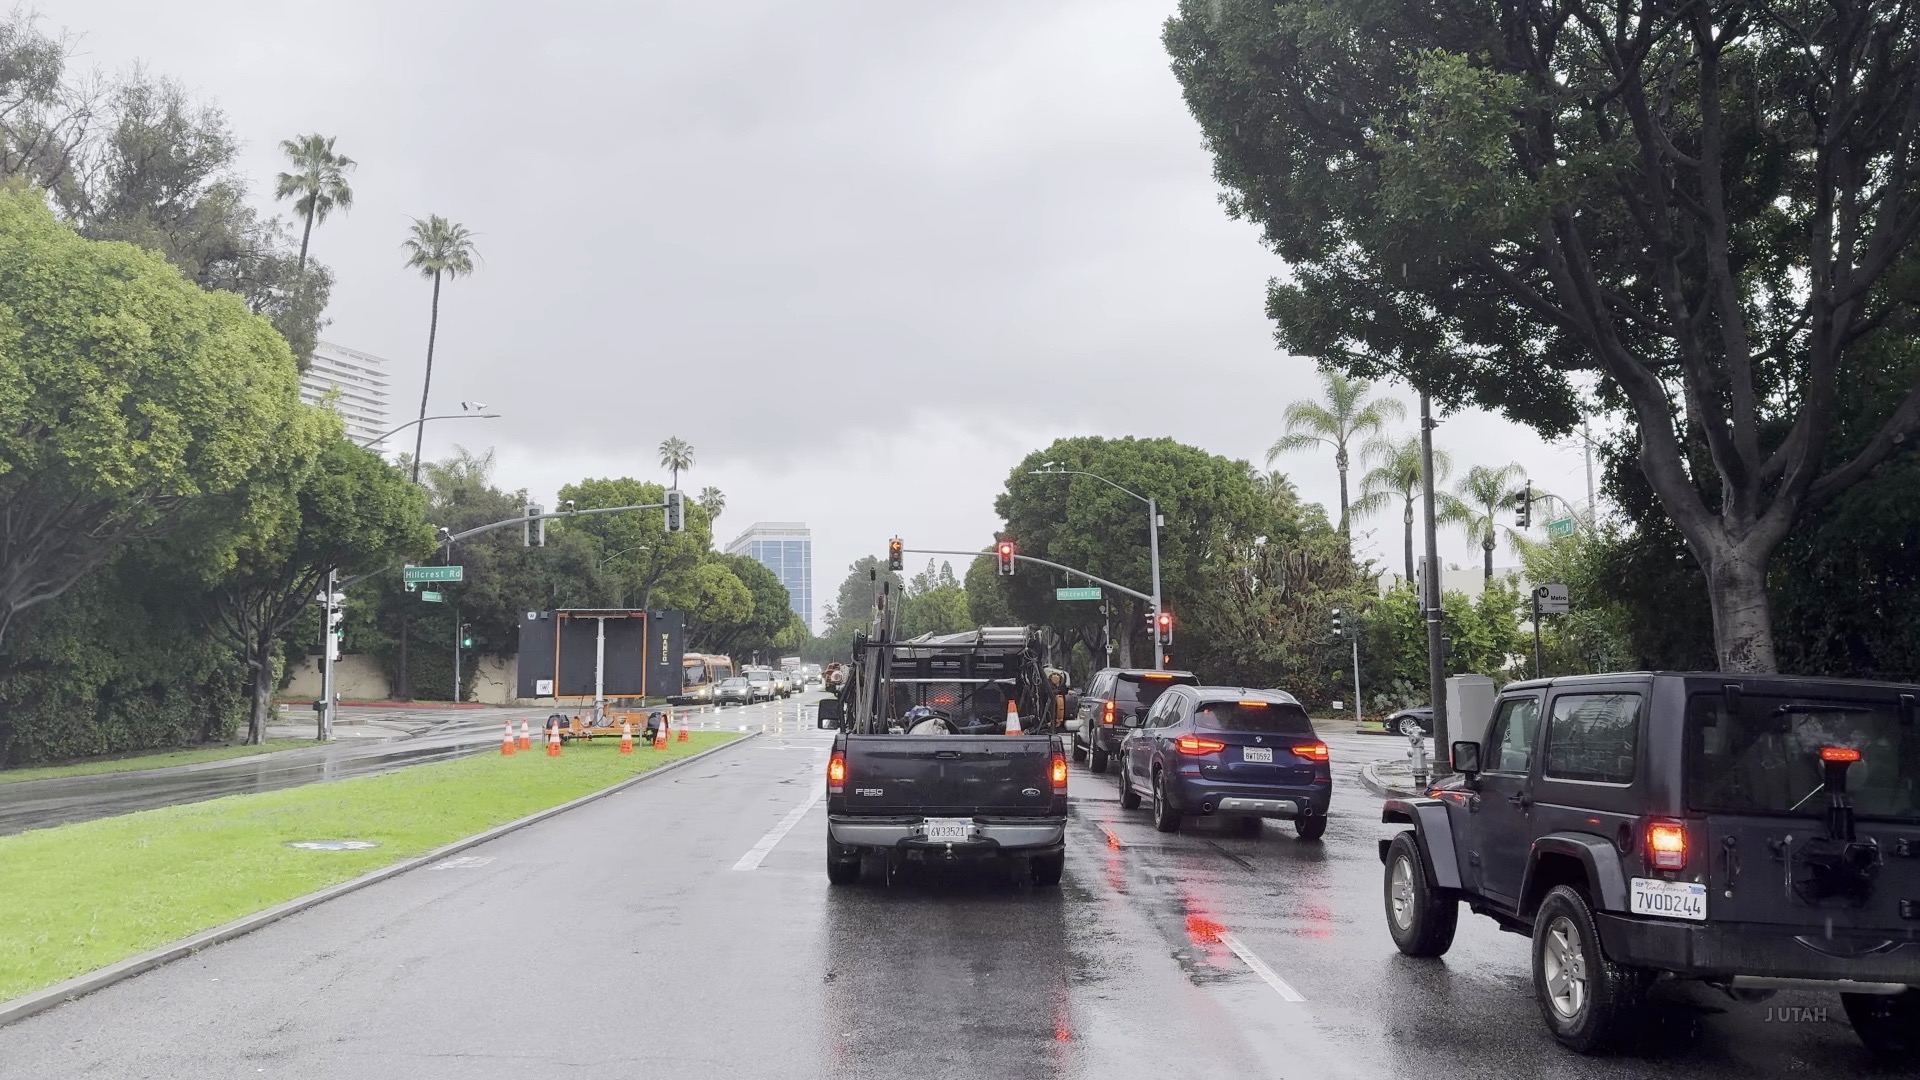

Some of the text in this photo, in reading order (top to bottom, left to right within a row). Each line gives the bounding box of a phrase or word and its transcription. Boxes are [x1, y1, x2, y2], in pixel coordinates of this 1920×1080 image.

[405, 569, 461, 579] Hillcrest Rd
[661, 633, 669, 662] WANCO
[930, 826, 965, 837] 6V33521
[1645, 881, 1689, 894] California
